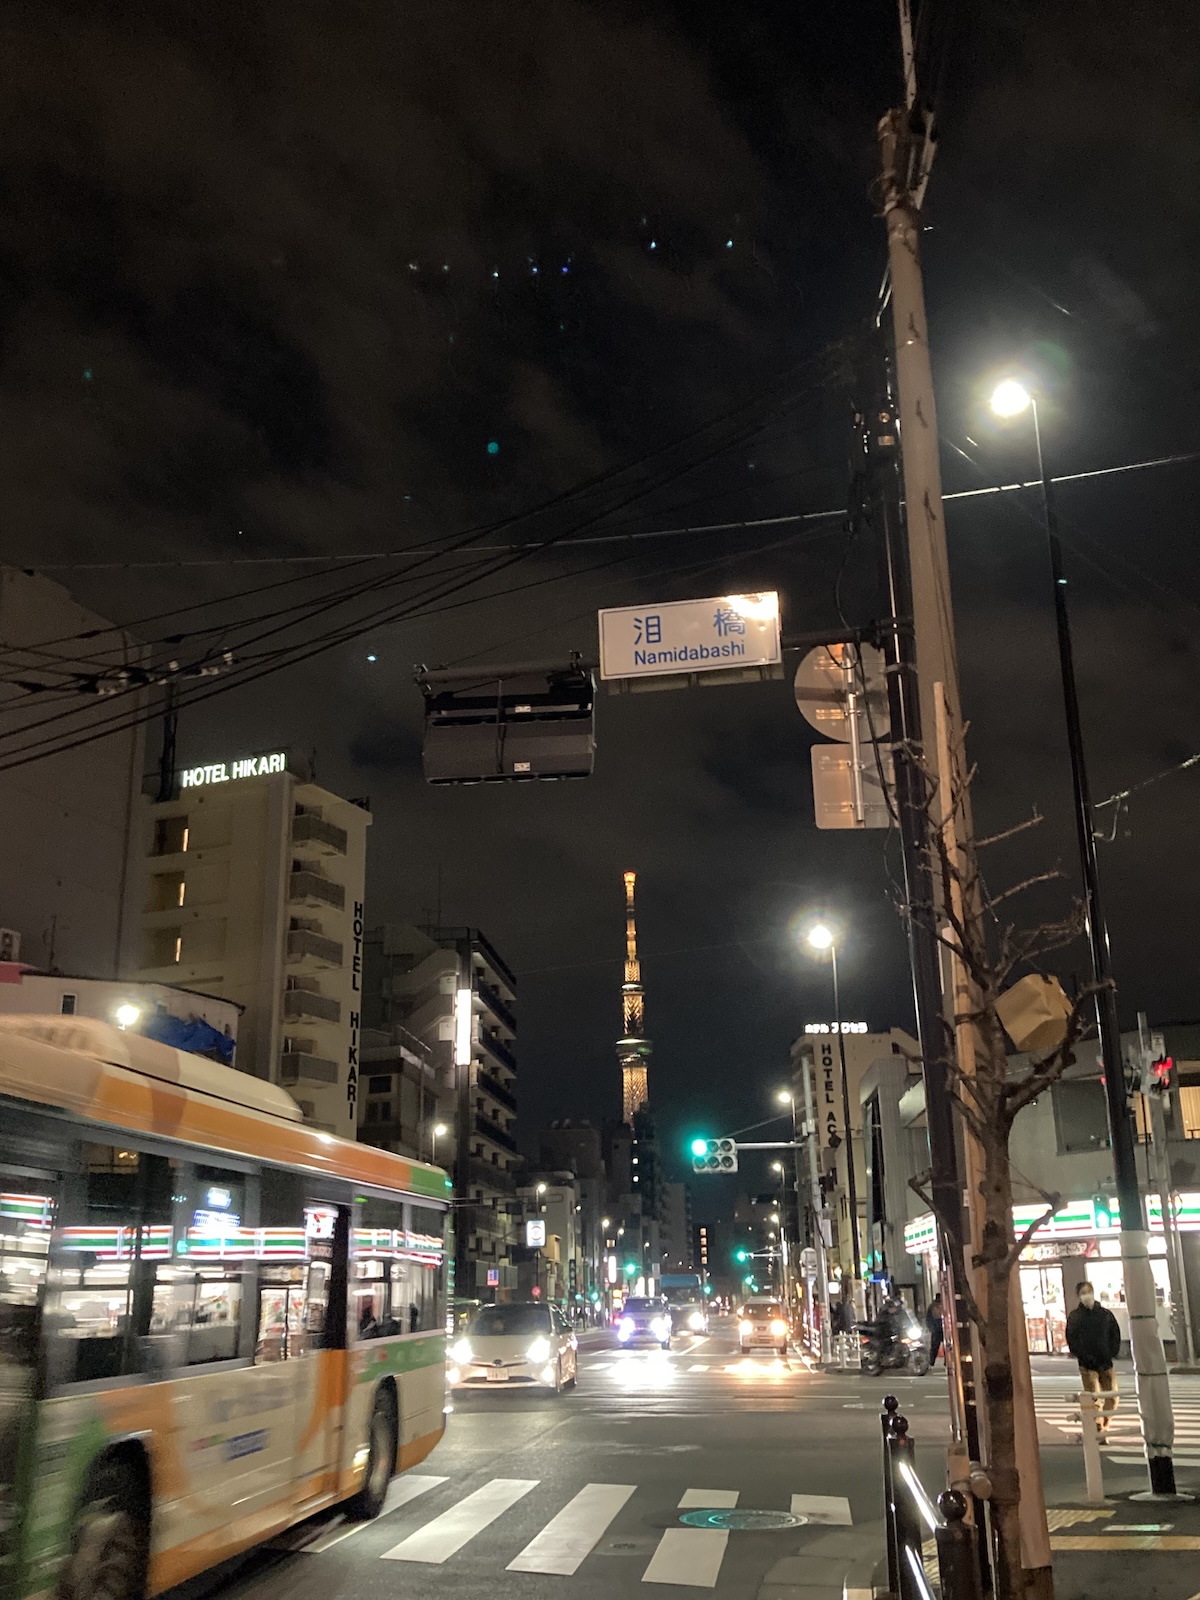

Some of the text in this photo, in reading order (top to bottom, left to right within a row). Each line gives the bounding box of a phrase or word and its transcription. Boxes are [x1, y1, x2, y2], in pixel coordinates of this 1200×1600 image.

[633, 608, 746, 645] 泪橋
[634, 639, 746, 666] Namidabashi
[182, 753, 286, 788] HOTEL HIKARI
[347, 901, 363, 1120] HOTEL HIKARI
[822, 1044, 838, 1140] HOTEL AC
